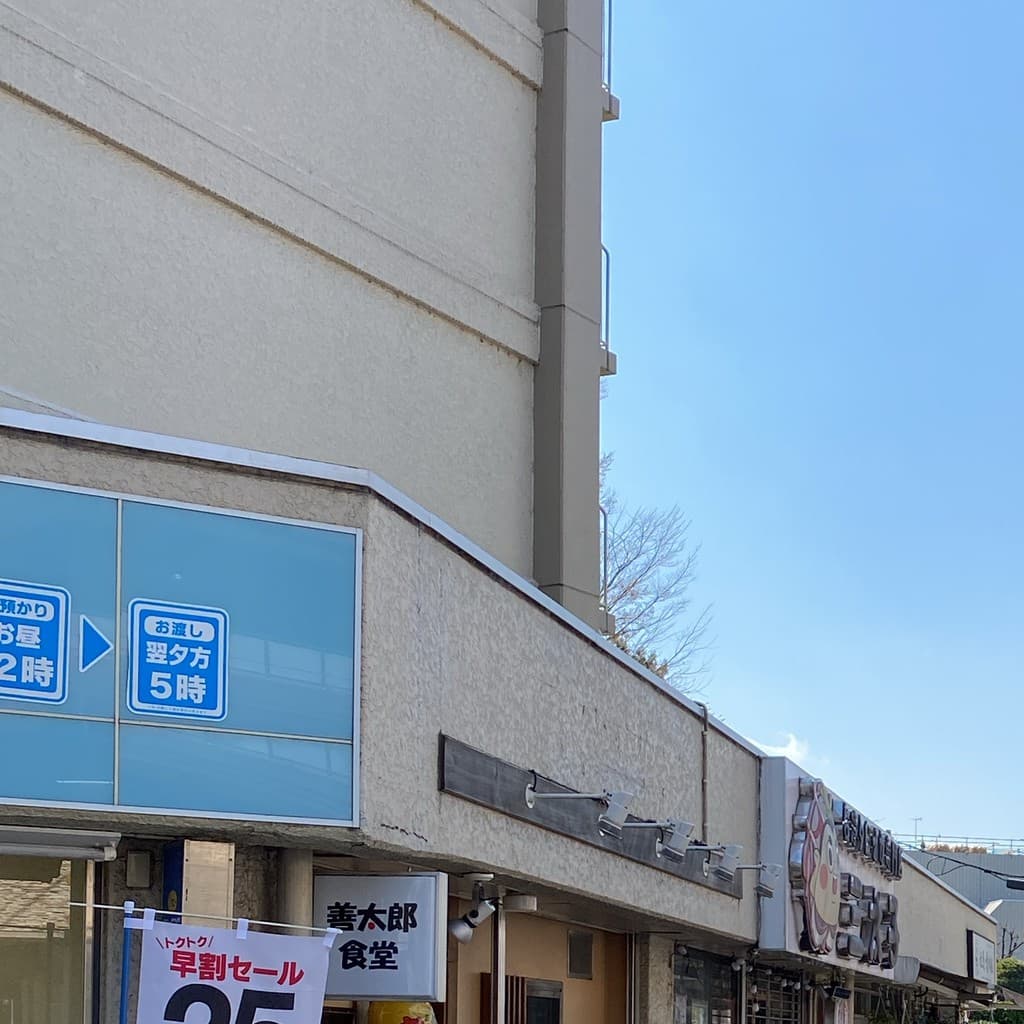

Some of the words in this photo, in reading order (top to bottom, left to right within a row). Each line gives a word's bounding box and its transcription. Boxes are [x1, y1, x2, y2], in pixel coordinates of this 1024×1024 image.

[155, 620, 203, 638] お渡し
[145, 640, 212, 670] 翌夕方
[149, 671, 207, 704] 5時
[326, 901, 418, 933] 善太郎
[164, 935, 208, 949] トクトク
[338, 939, 399, 970] 食堂
[169, 949, 305, 986] 早割セール
